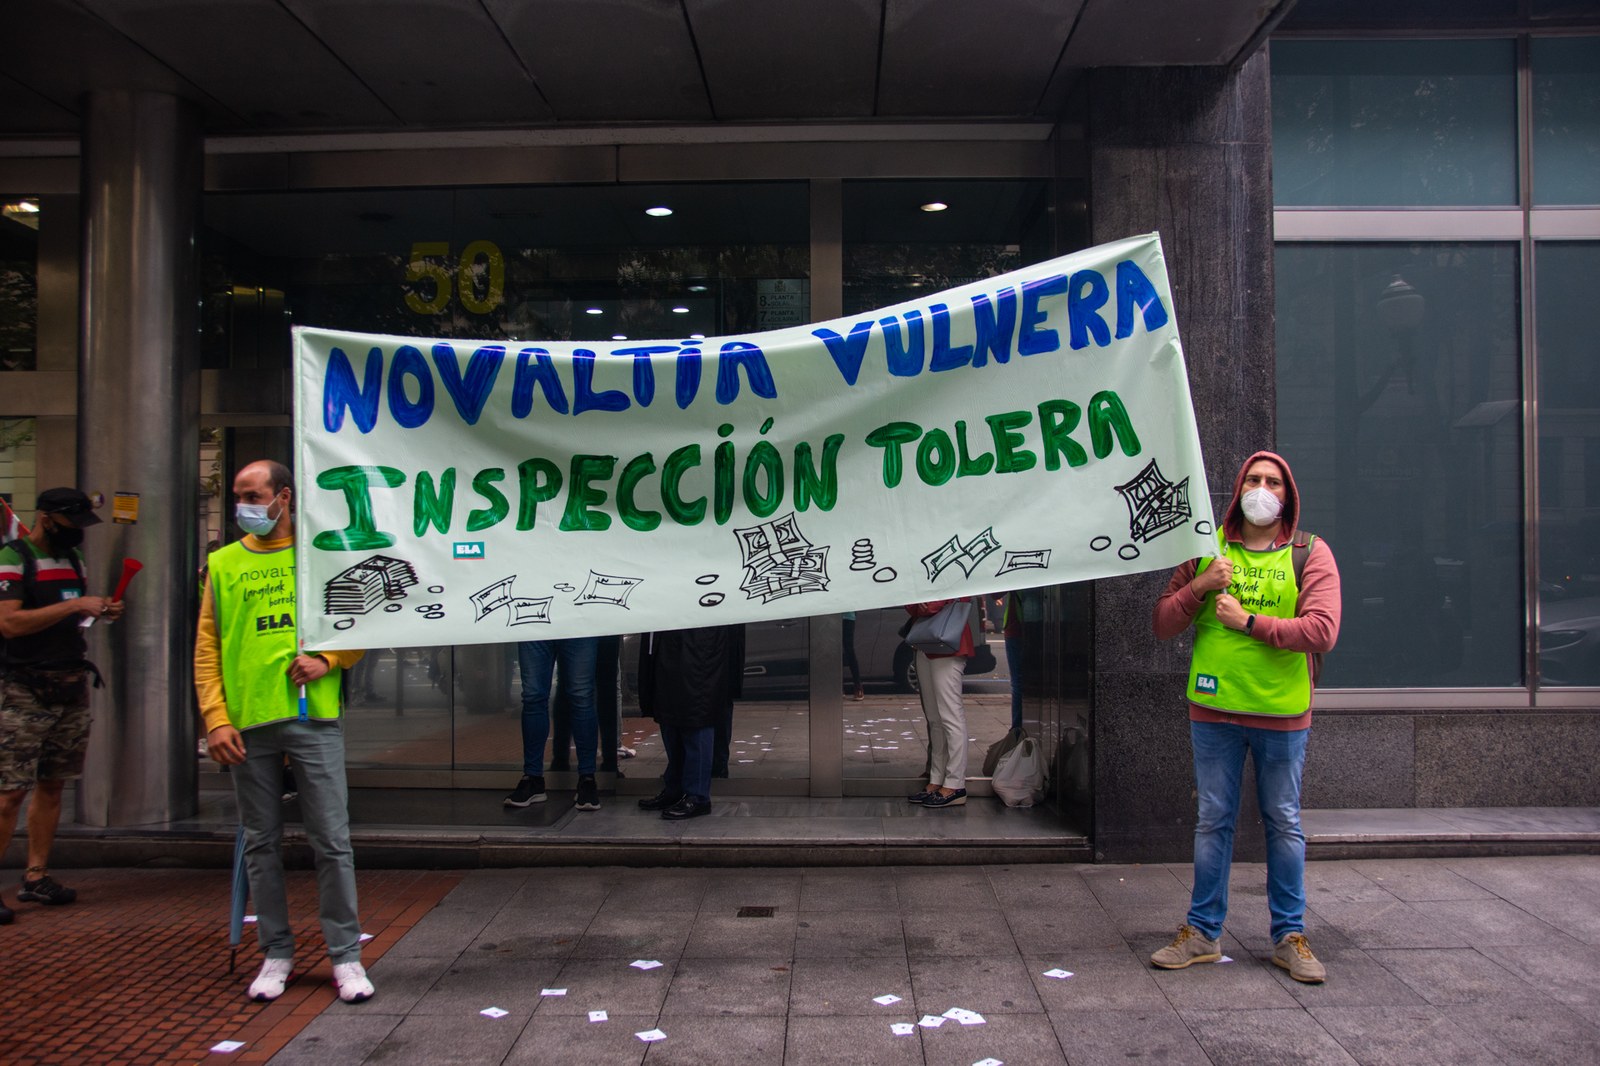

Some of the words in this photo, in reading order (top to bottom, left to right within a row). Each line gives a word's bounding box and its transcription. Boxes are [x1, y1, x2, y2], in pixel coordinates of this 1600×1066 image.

[403, 239, 506, 316] 50
[811, 259, 1169, 386] VULNERA
[865, 390, 1142, 489] TOLERA
[456, 544, 482, 555] ELA
[256, 613, 295, 632] ELA
[1197, 676, 1215, 690] ELA
